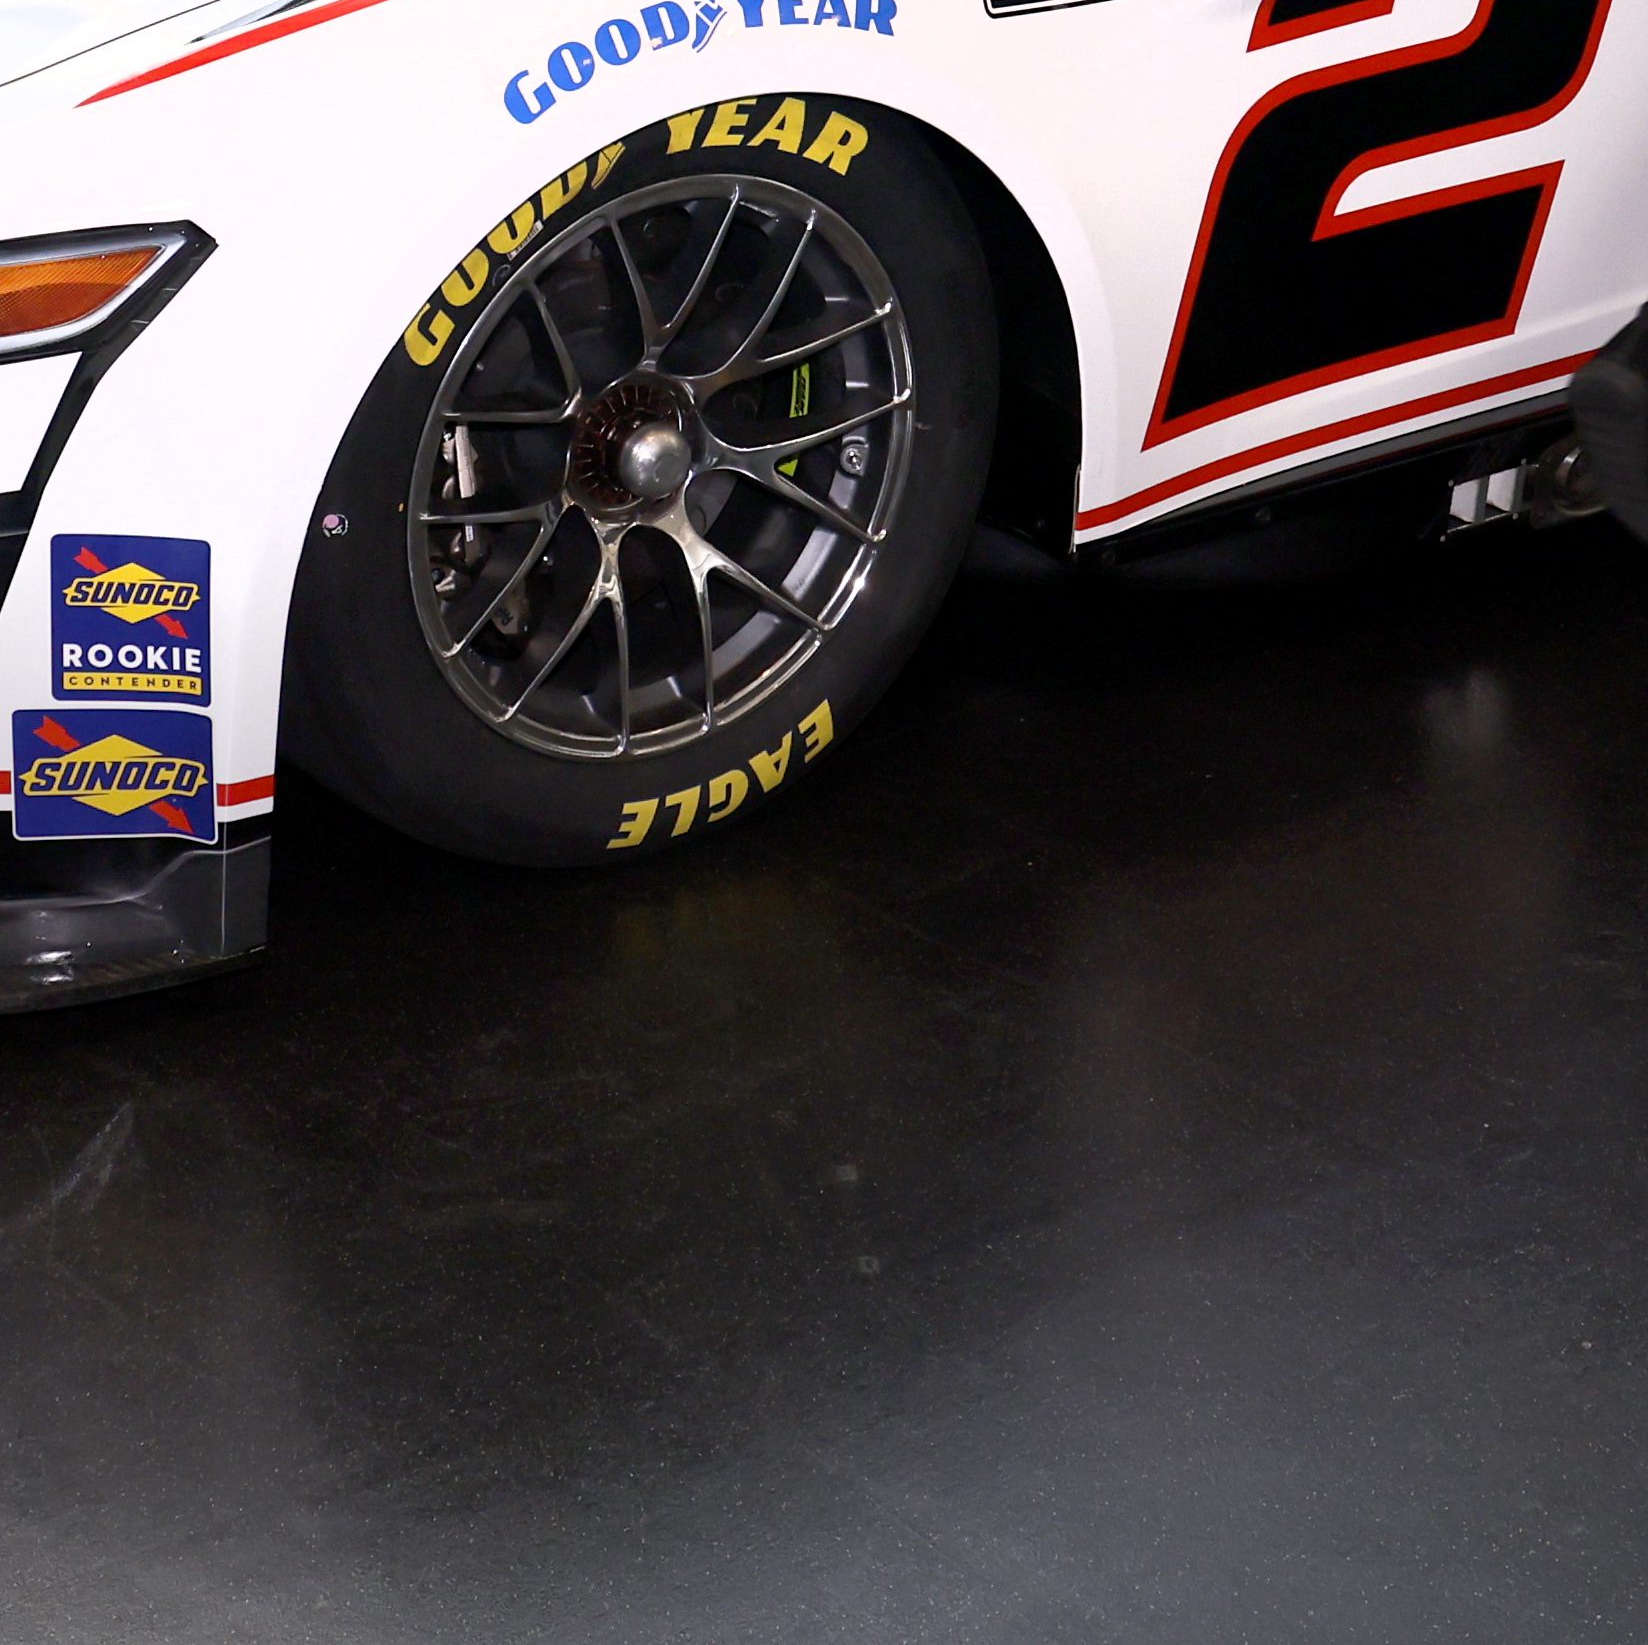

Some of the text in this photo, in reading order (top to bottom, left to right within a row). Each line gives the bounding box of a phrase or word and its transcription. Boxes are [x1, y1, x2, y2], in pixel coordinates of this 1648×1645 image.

[663, 97, 870, 177] YEAR
[68, 580, 197, 610] SUNOCO
[62, 642, 202, 674] ROOKIE
[68, 675, 199, 692] CONTENDER
[28, 760, 202, 793] SUNOCO
[605, 698, 835, 850] EAGLE
